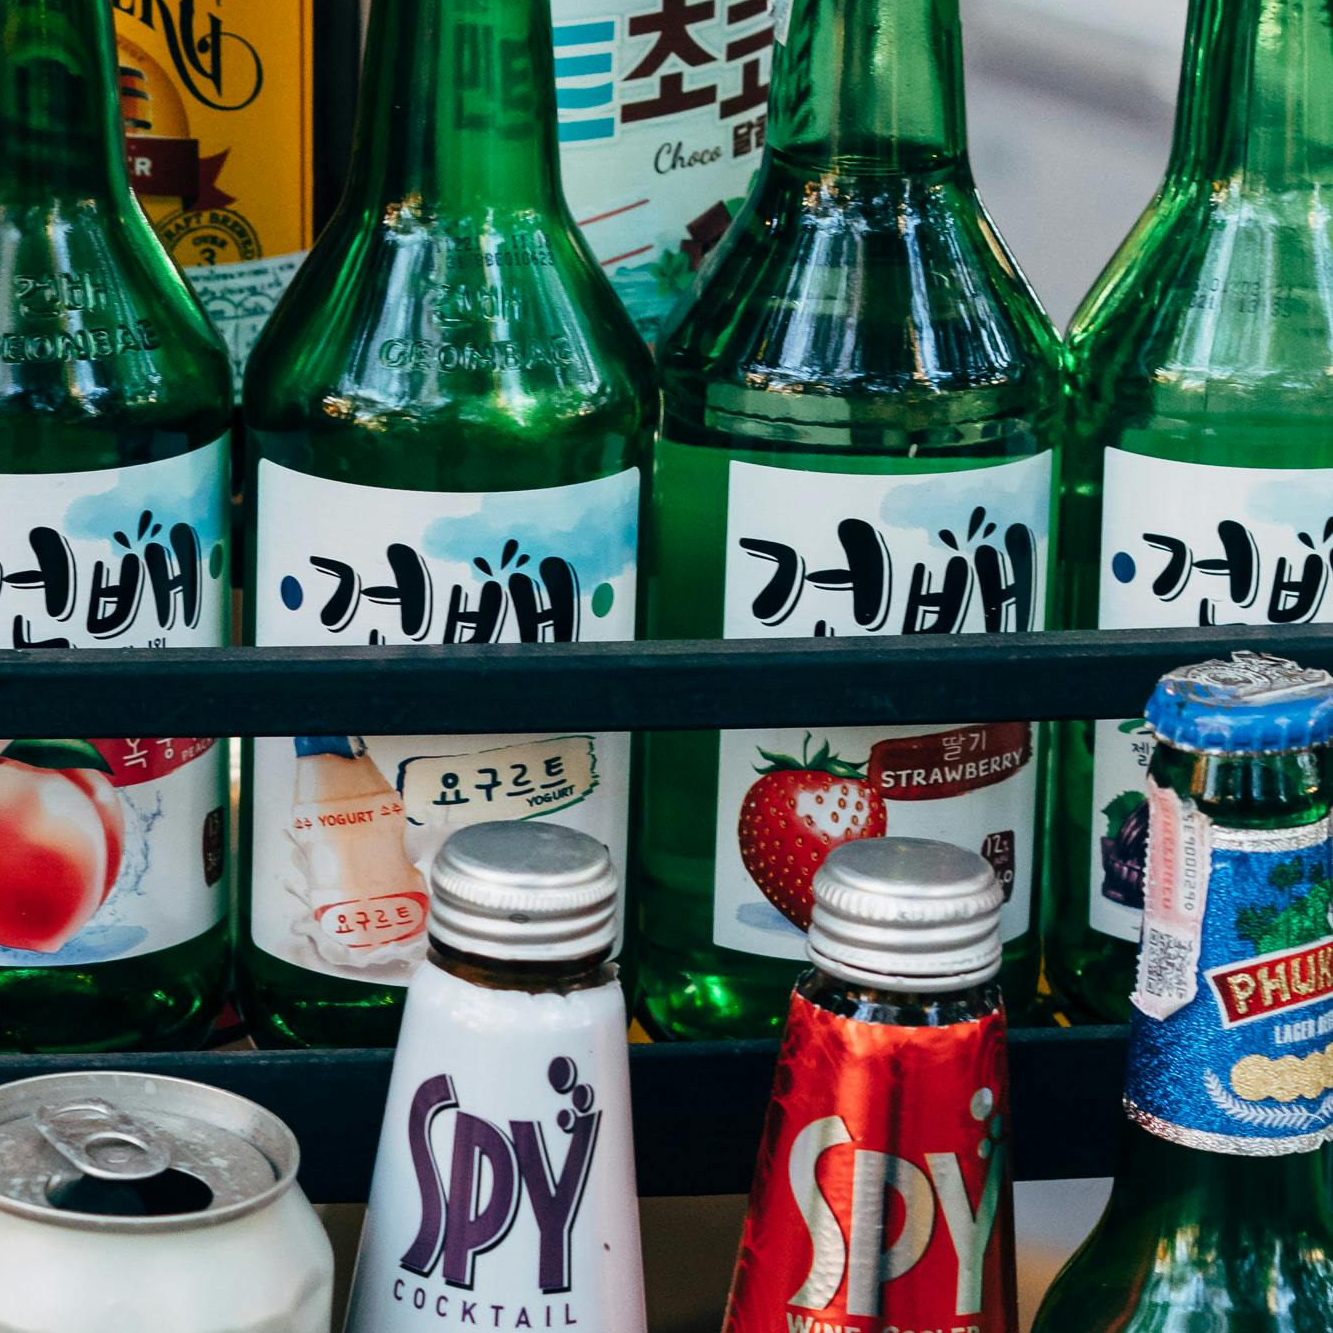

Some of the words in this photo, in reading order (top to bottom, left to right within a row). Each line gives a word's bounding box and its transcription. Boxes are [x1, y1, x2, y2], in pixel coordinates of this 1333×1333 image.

[654, 140, 723, 175] Choco
[941, 729, 988, 763] 딸기
[432, 755, 568, 807] 요구르트
[880, 746, 1025, 790] STRAWBERRY
[526, 783, 576, 809] YOGURT
[317, 808, 375, 829] YOGURT
[379, 803, 404, 819] 소주
[334, 905, 415, 936] 요구르트
[399, 1069, 604, 1296] SPY
[786, 1113, 1004, 1318] SPY
[393, 1277, 578, 1330] COCKTAIL
